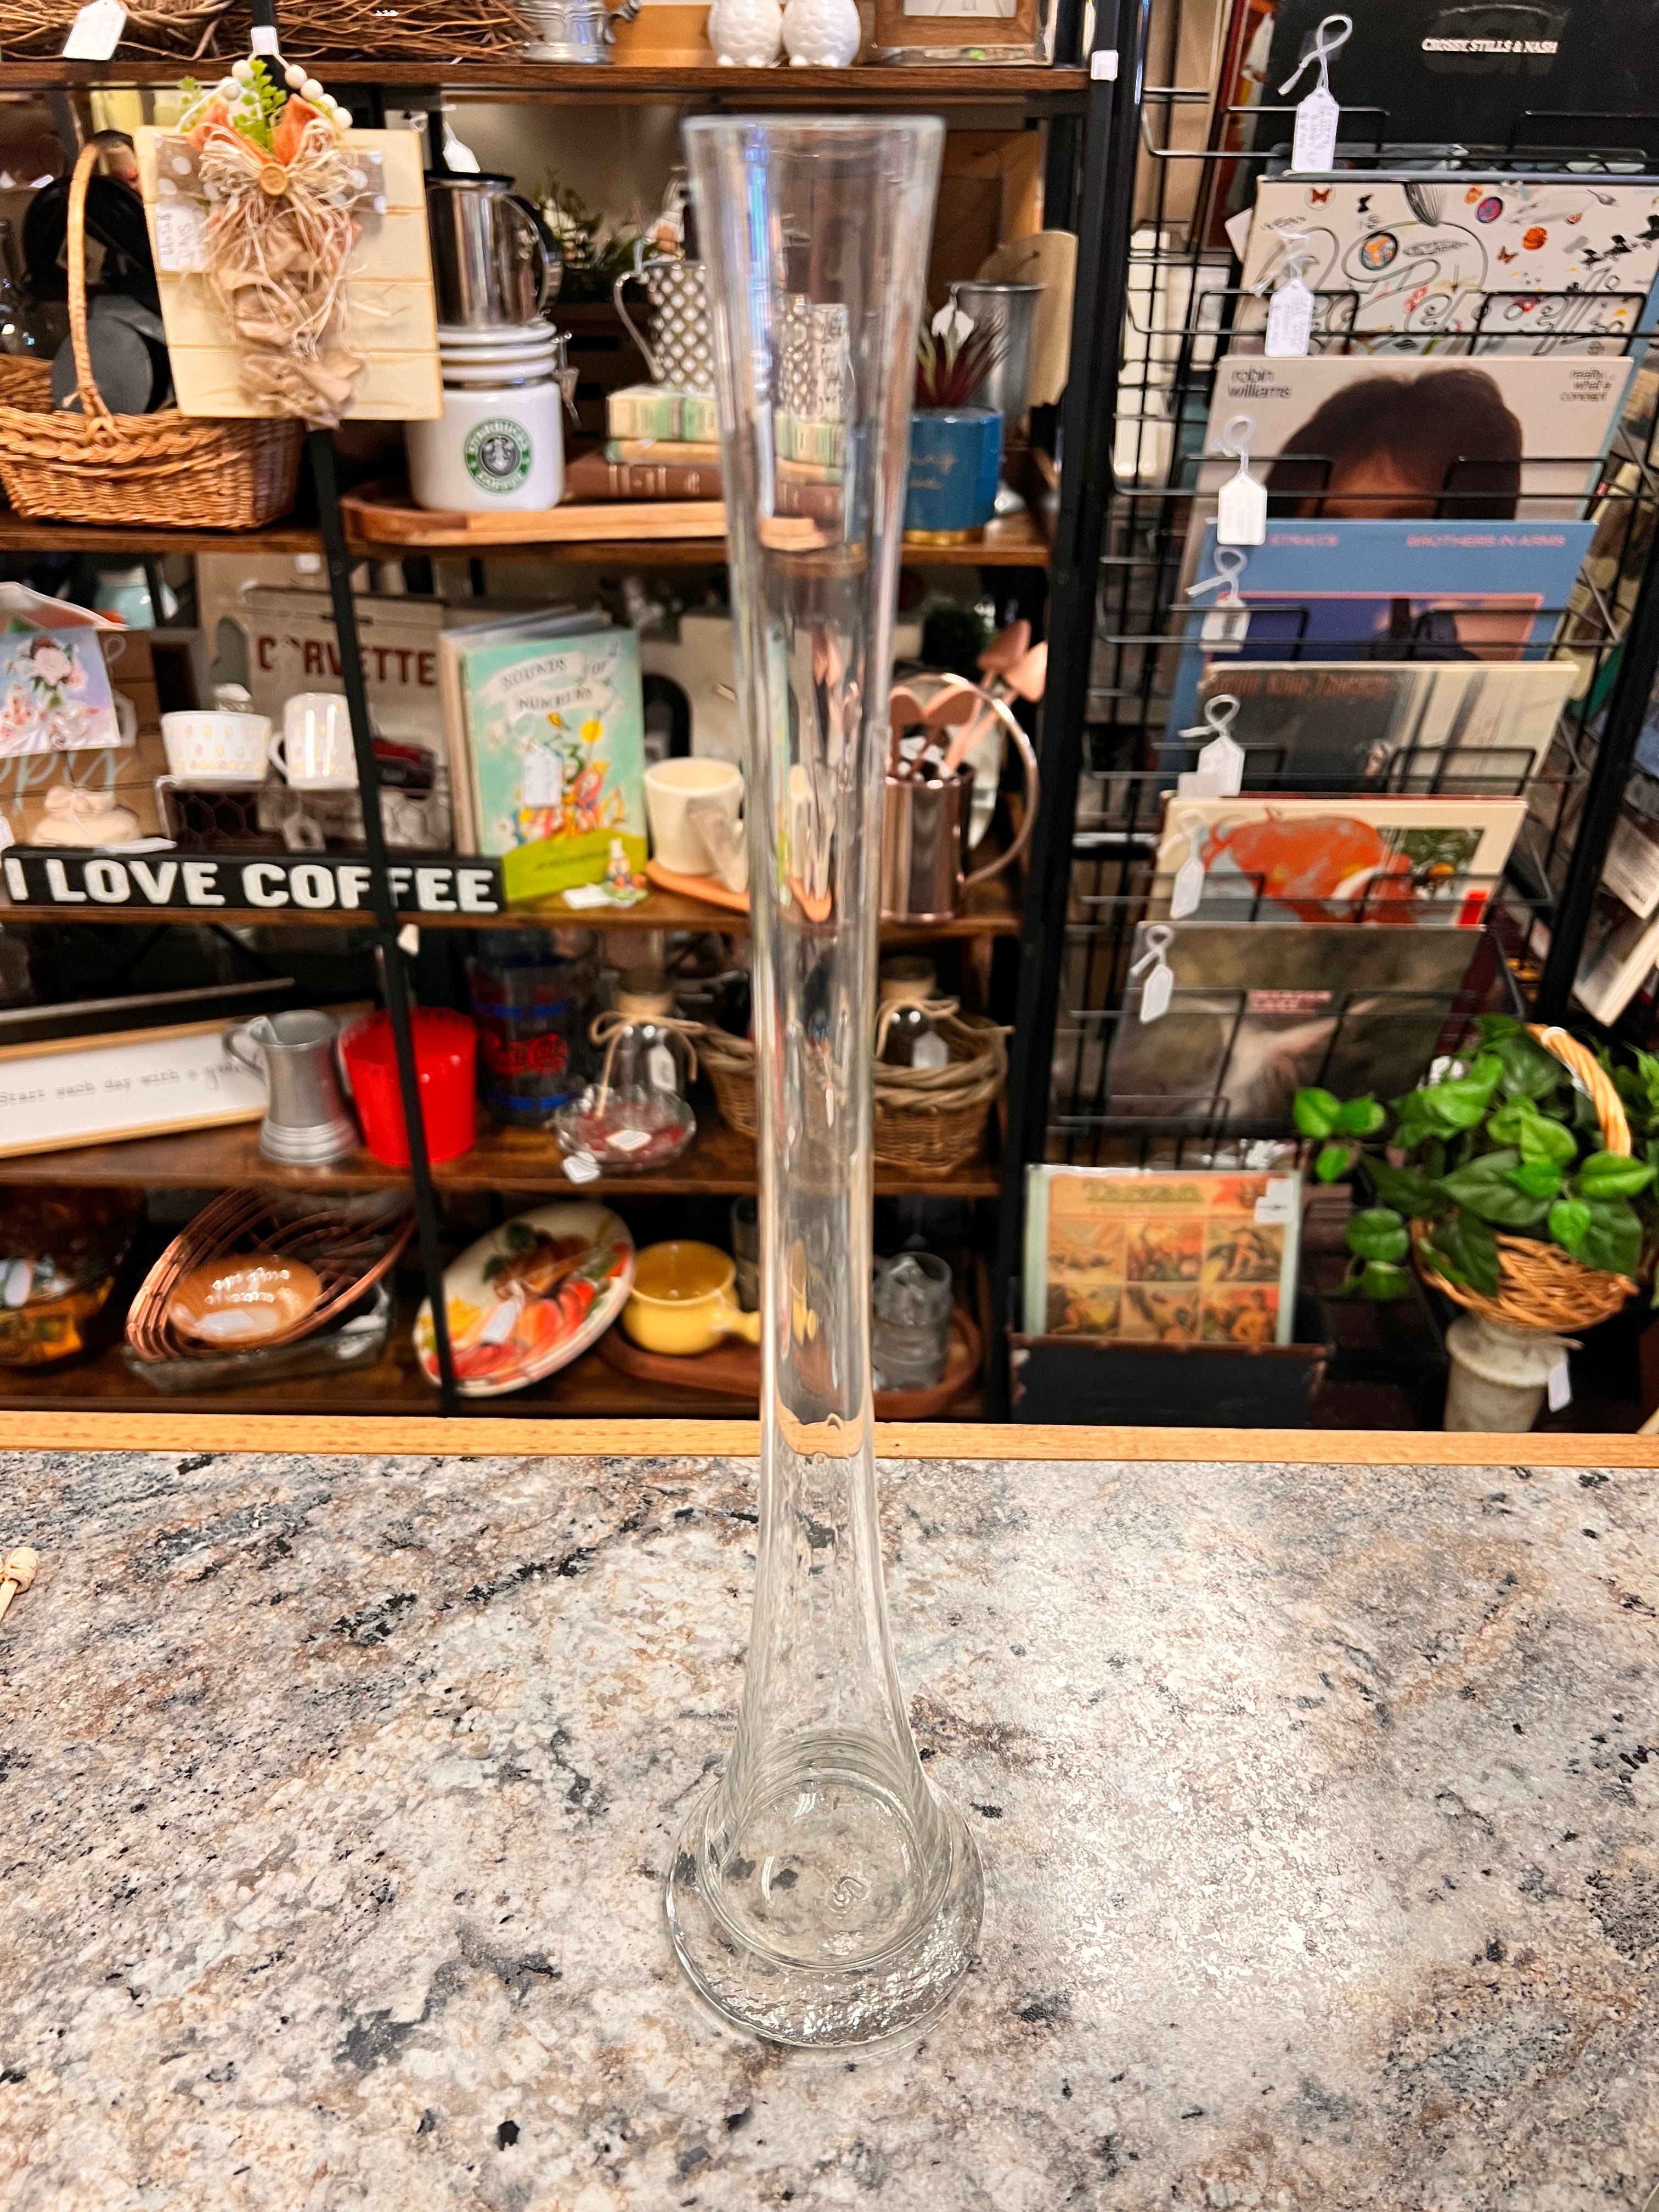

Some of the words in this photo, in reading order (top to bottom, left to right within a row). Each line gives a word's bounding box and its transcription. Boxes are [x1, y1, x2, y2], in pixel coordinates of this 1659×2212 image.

[4, 857, 29, 901] I
[46, 859, 225, 906] LOVE
[242, 862, 499, 913] COFFEE
